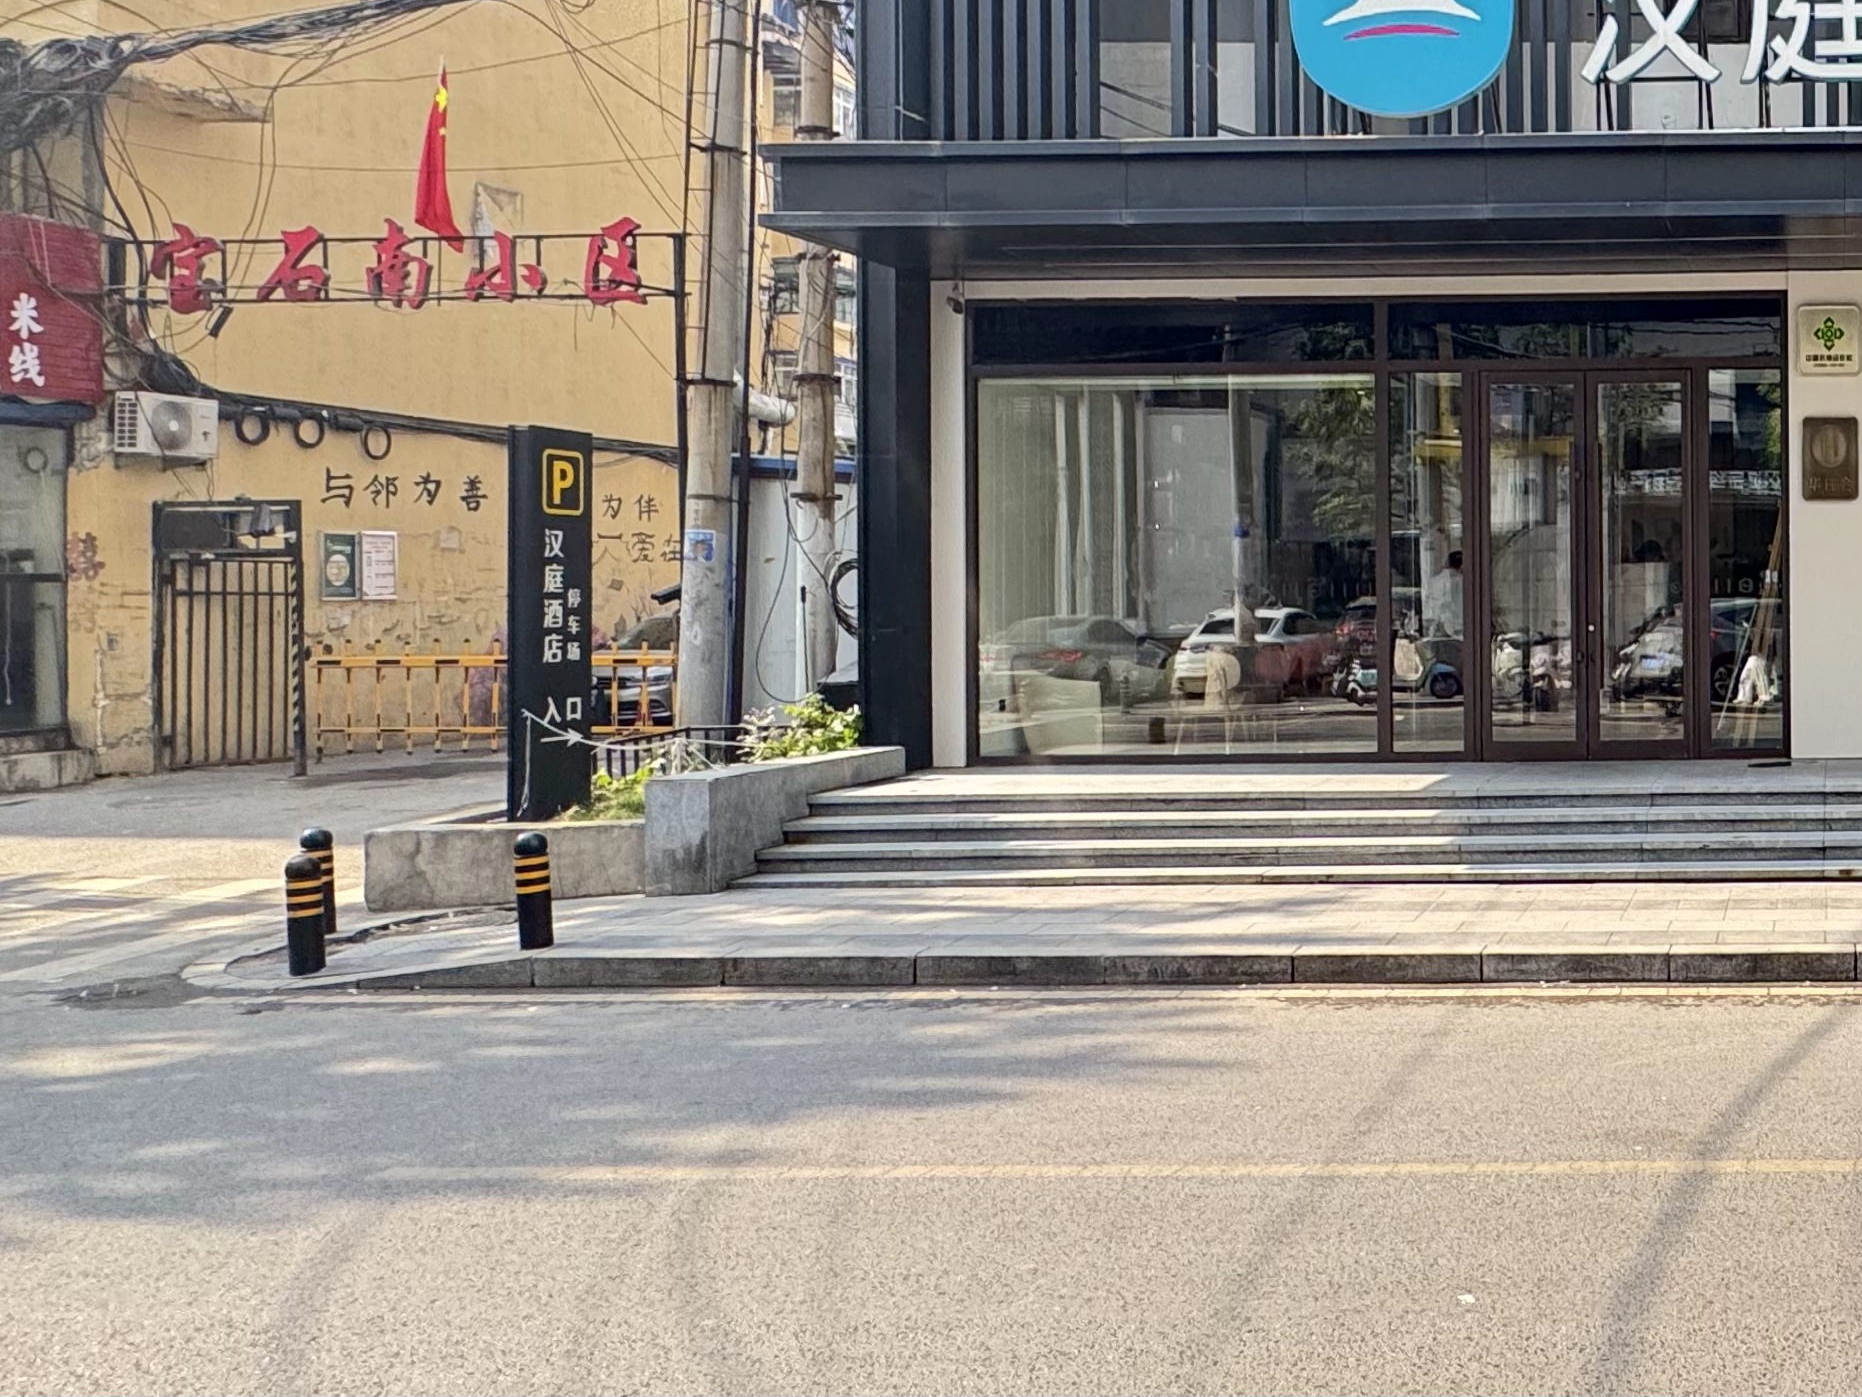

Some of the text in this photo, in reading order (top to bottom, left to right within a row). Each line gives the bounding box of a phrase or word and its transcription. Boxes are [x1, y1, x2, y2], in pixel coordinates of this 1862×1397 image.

[150, 217, 648, 315] 宝石南小区
[8, 292, 46, 387] 米线
[320, 466, 488, 512] 与邻为善
[553, 461, 574, 504] P
[602, 493, 660, 524] 为伴
[543, 528, 565, 664] 汉庭酒店
[566, 587, 581, 662] 停车场
[542, 697, 582, 725] 入口
